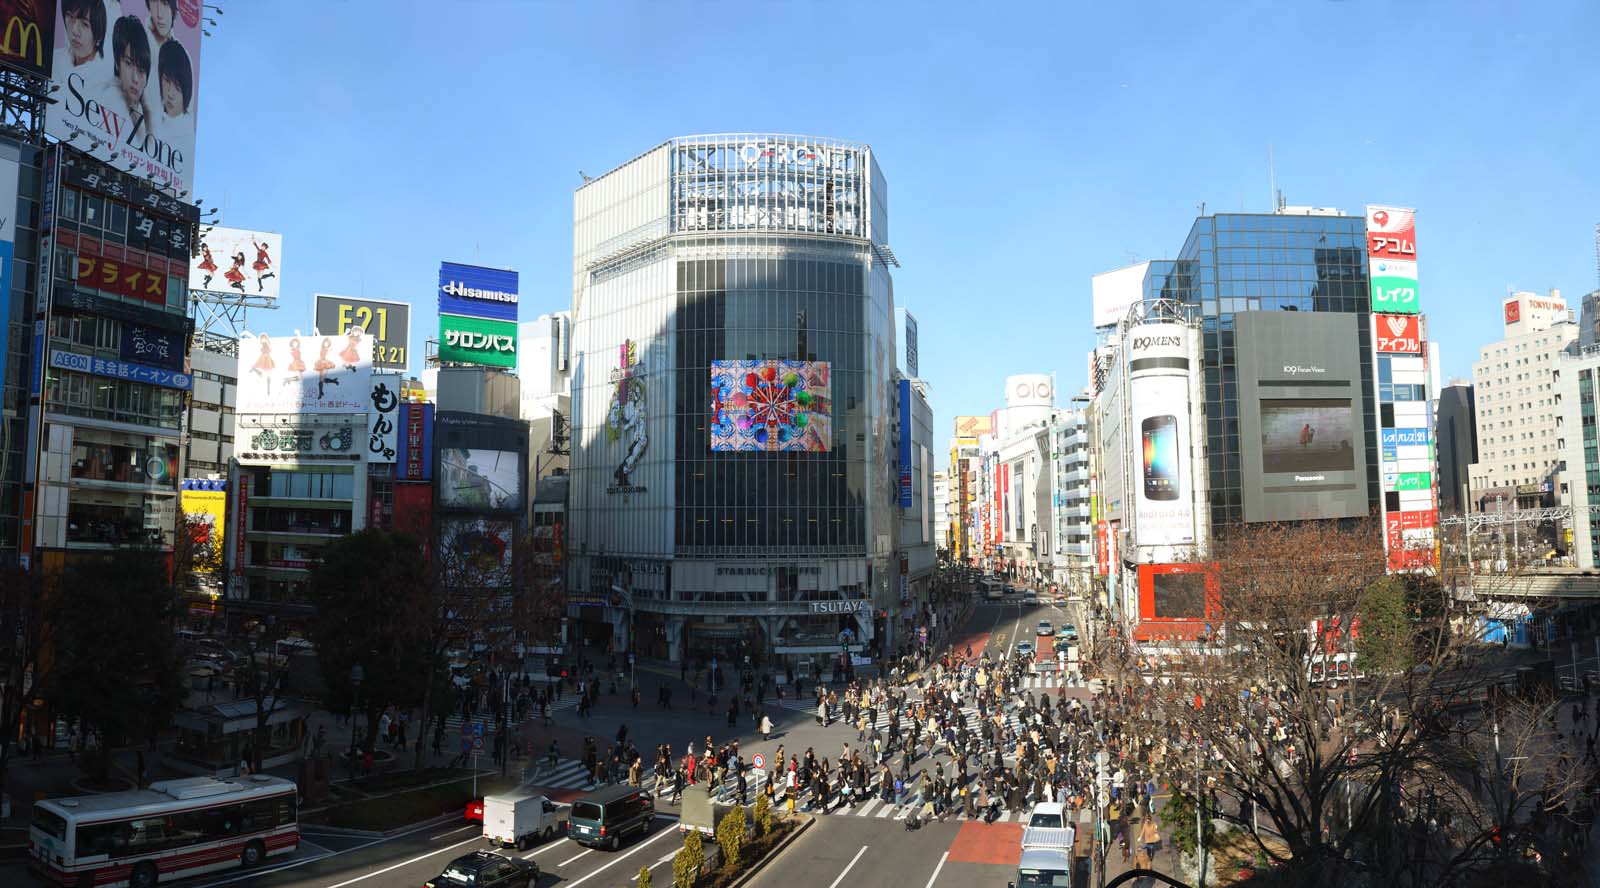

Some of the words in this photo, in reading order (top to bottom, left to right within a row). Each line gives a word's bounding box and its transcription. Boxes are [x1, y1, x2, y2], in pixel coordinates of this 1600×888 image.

[65, 73, 127, 151] Sexy
[125, 108, 183, 174] Zone
[1373, 237, 1414, 254] アコム
[441, 280, 518, 303] Hisamitsu
[1376, 286, 1414, 303] レイク
[1528, 300, 1551, 310] TOKYU
[1552, 303, 1565, 311] INN
[443, 329, 515, 353] サロンパス
[1378, 337, 1418, 351] アイフル
[54, 352, 88, 370] AEON
[389, 346, 405, 363] 21
[369, 382, 398, 460] もんじゃ
[811, 601, 865, 613] TSUTAYA
